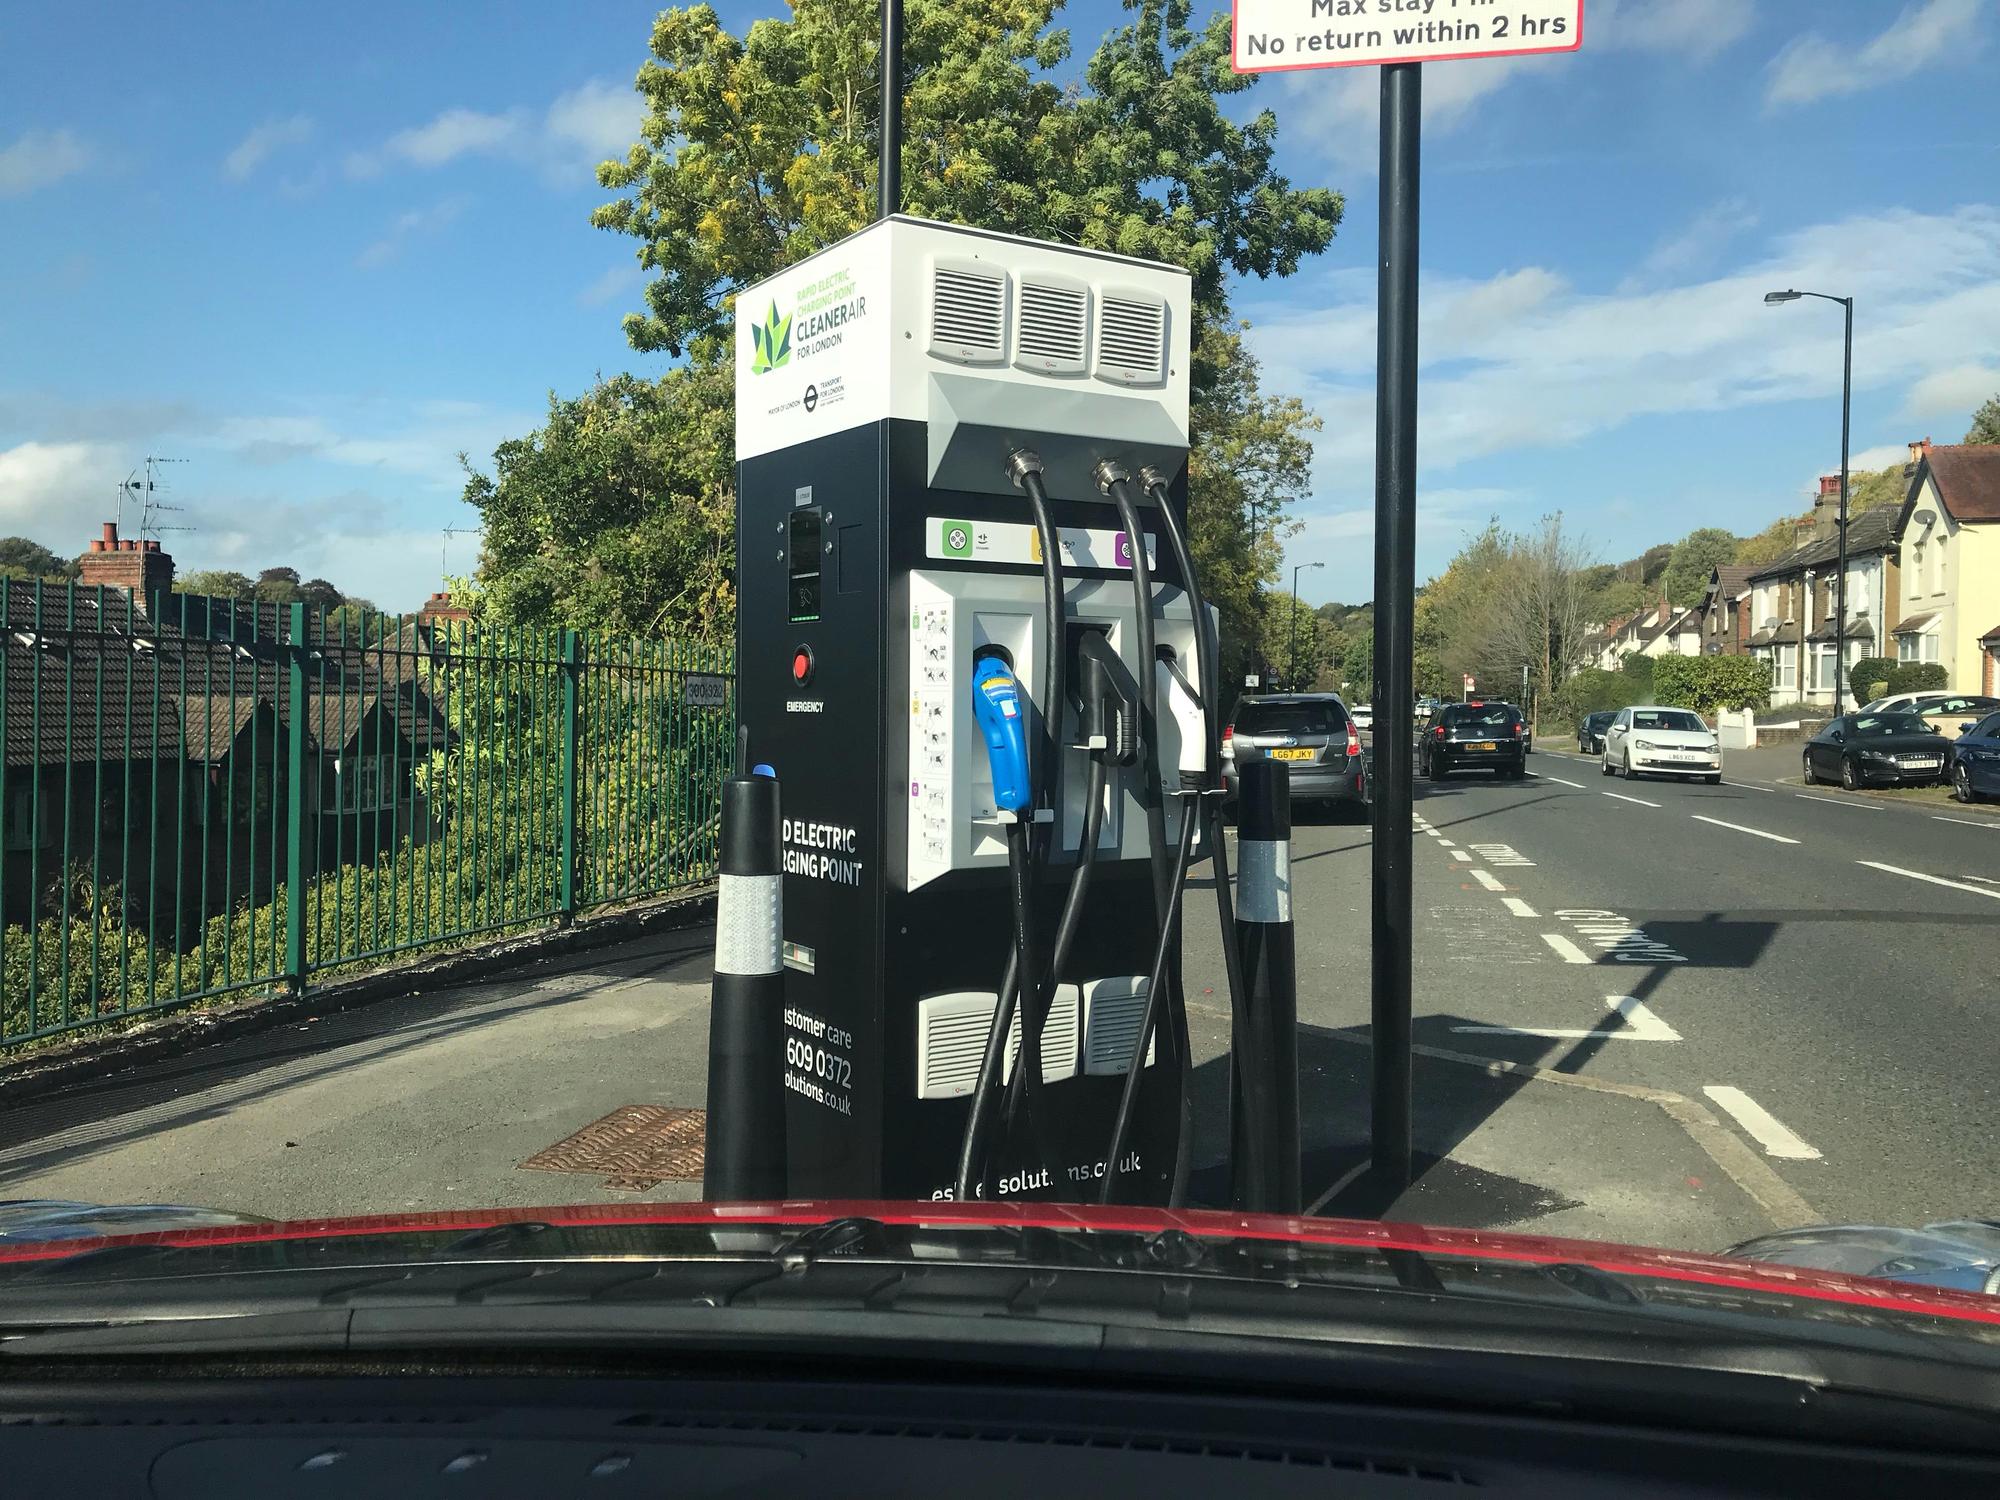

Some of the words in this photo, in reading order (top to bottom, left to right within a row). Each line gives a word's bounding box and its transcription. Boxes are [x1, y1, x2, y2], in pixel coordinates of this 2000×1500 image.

[1311, 0, 1367, 18] Max
[1248, 34, 1285, 55] No
[1296, 29, 1381, 52] return
[1393, 19, 1480, 45] within
[1492, 15, 1509, 38] 2
[1521, 14, 1566, 36] hrs
[797, 283, 817, 301] RAPID
[818, 267, 850, 293] ELECTRIC
[797, 292, 833, 318] CHARGING
[834, 281, 856, 303] POINT
[797, 345, 811, 360] FOR
[811, 332, 842, 355] LONDON
[786, 701, 824, 713] EMERGENCY
[1272, 749, 1294, 759] LG67
[1296, 750, 1312, 759] JKY
[794, 820, 856, 854] ELECTRIC
[783, 849, 818, 878] GING
[820, 855, 863, 887] POINT
[784, 1008, 826, 1039] stomer
[827, 1024, 852, 1050] care
[816, 1049, 852, 1090] 0372
